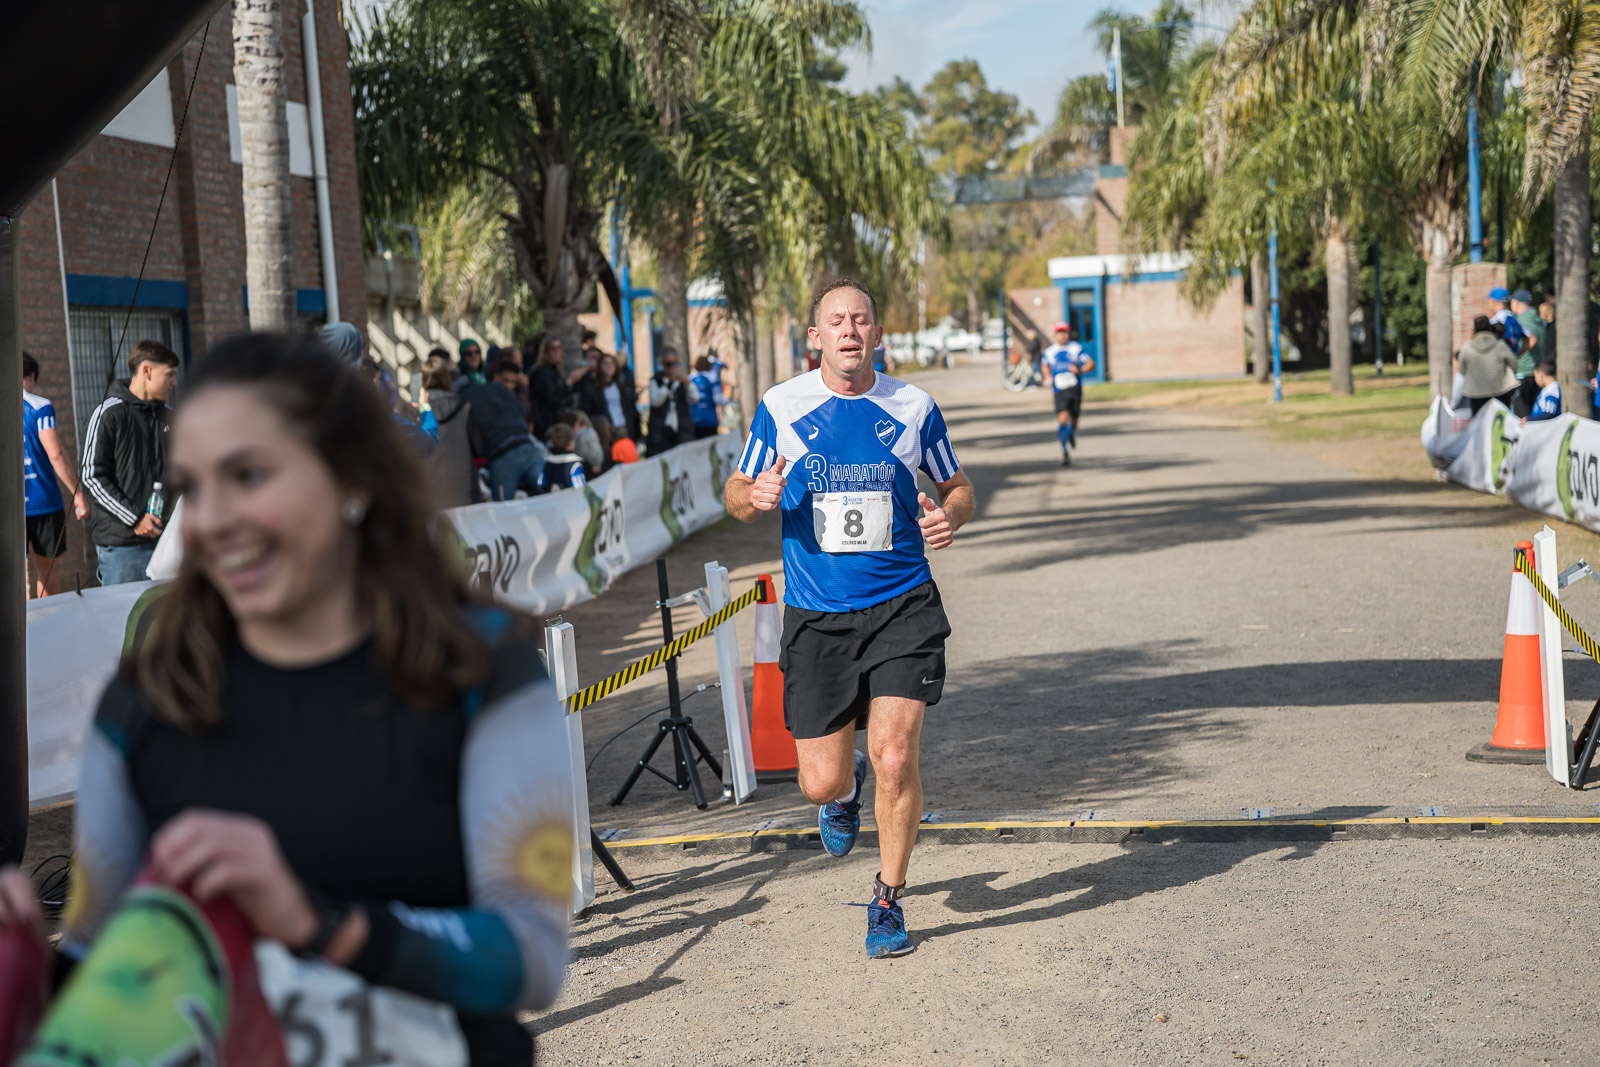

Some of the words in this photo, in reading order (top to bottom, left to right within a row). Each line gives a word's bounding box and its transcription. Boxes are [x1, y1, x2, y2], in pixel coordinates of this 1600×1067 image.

[805, 453, 829, 493] 3
[829, 461, 896, 481] MARATÓN
[844, 509, 864, 537] 8
